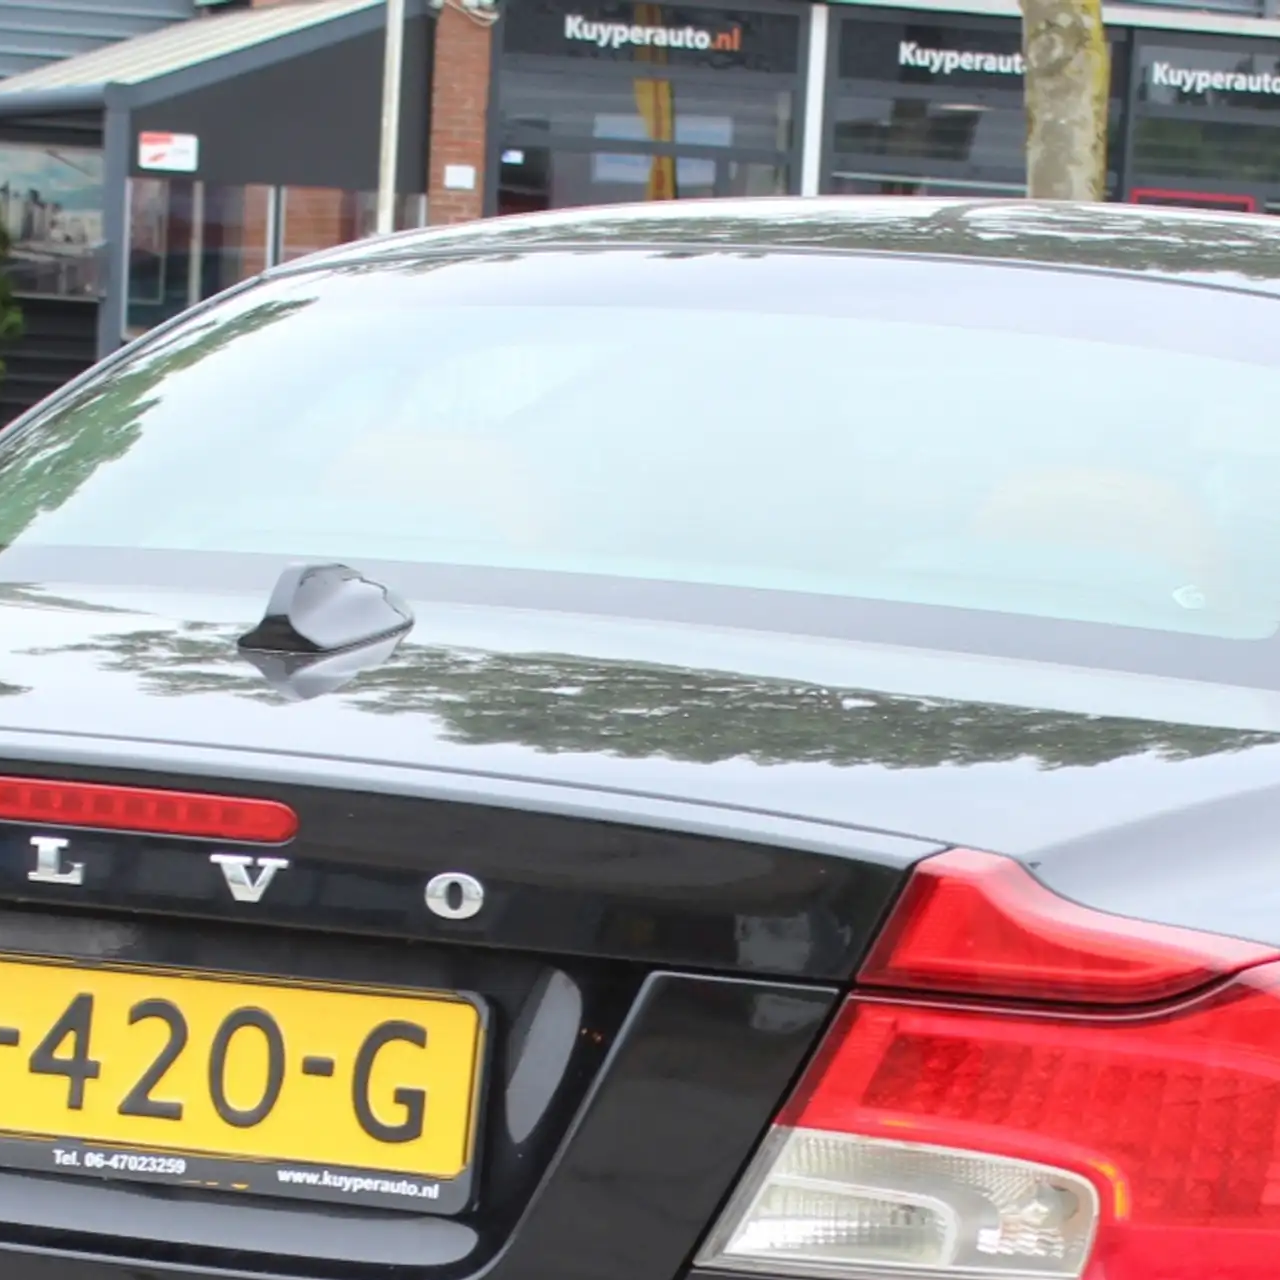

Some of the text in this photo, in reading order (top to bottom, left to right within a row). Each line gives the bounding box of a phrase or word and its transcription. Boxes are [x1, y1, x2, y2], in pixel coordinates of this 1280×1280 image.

[564, 14, 742, 51] Kuyperauto.nl
[898, 41, 1027, 75] Kuyperaut
[52, 1149, 81, 1167] Tel.
[83, 1151, 187, 1175] 06-47023259
[276, 1168, 440, 1199] www.kuyperauto.nl
